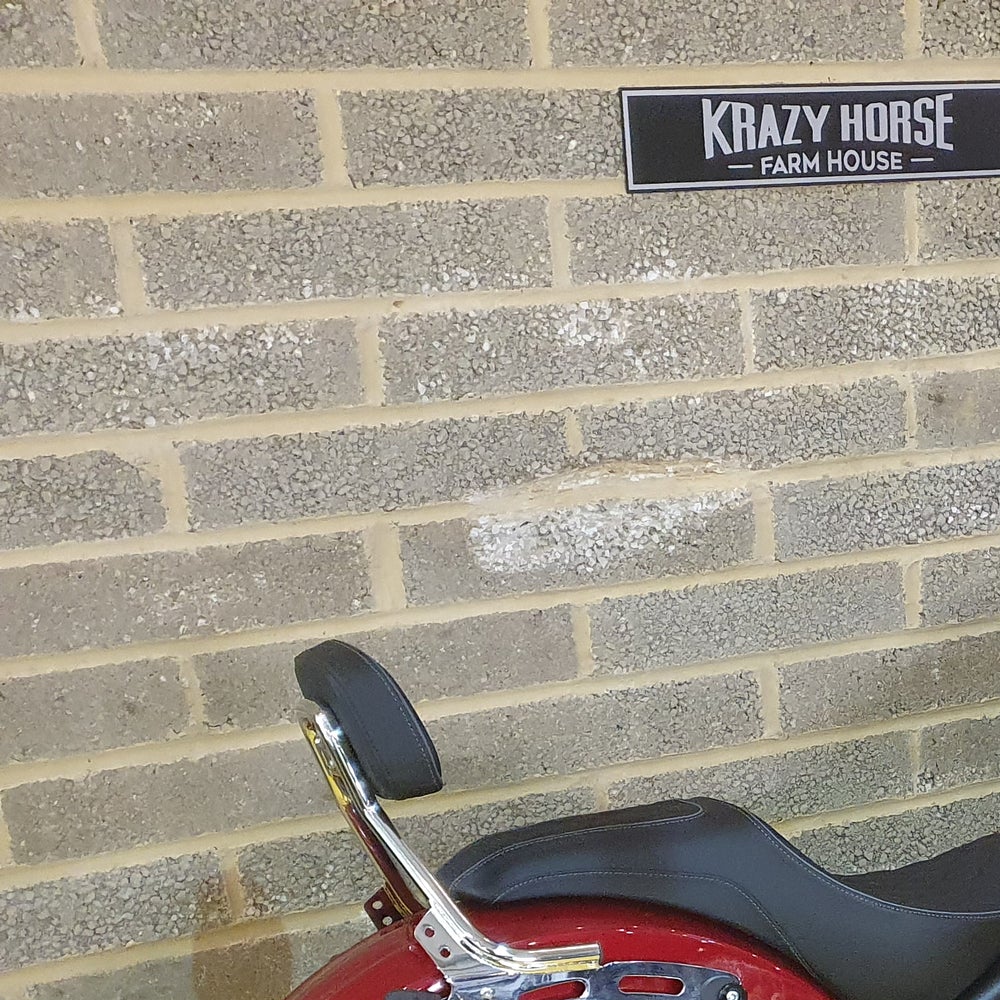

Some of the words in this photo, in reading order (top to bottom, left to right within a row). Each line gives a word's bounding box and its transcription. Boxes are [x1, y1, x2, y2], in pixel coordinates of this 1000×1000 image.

[701, 98, 830, 159] KRAZY
[840, 92, 954, 152] HORSE
[760, 151, 821, 175] FARM
[827, 149, 903, 173] HOUSE
